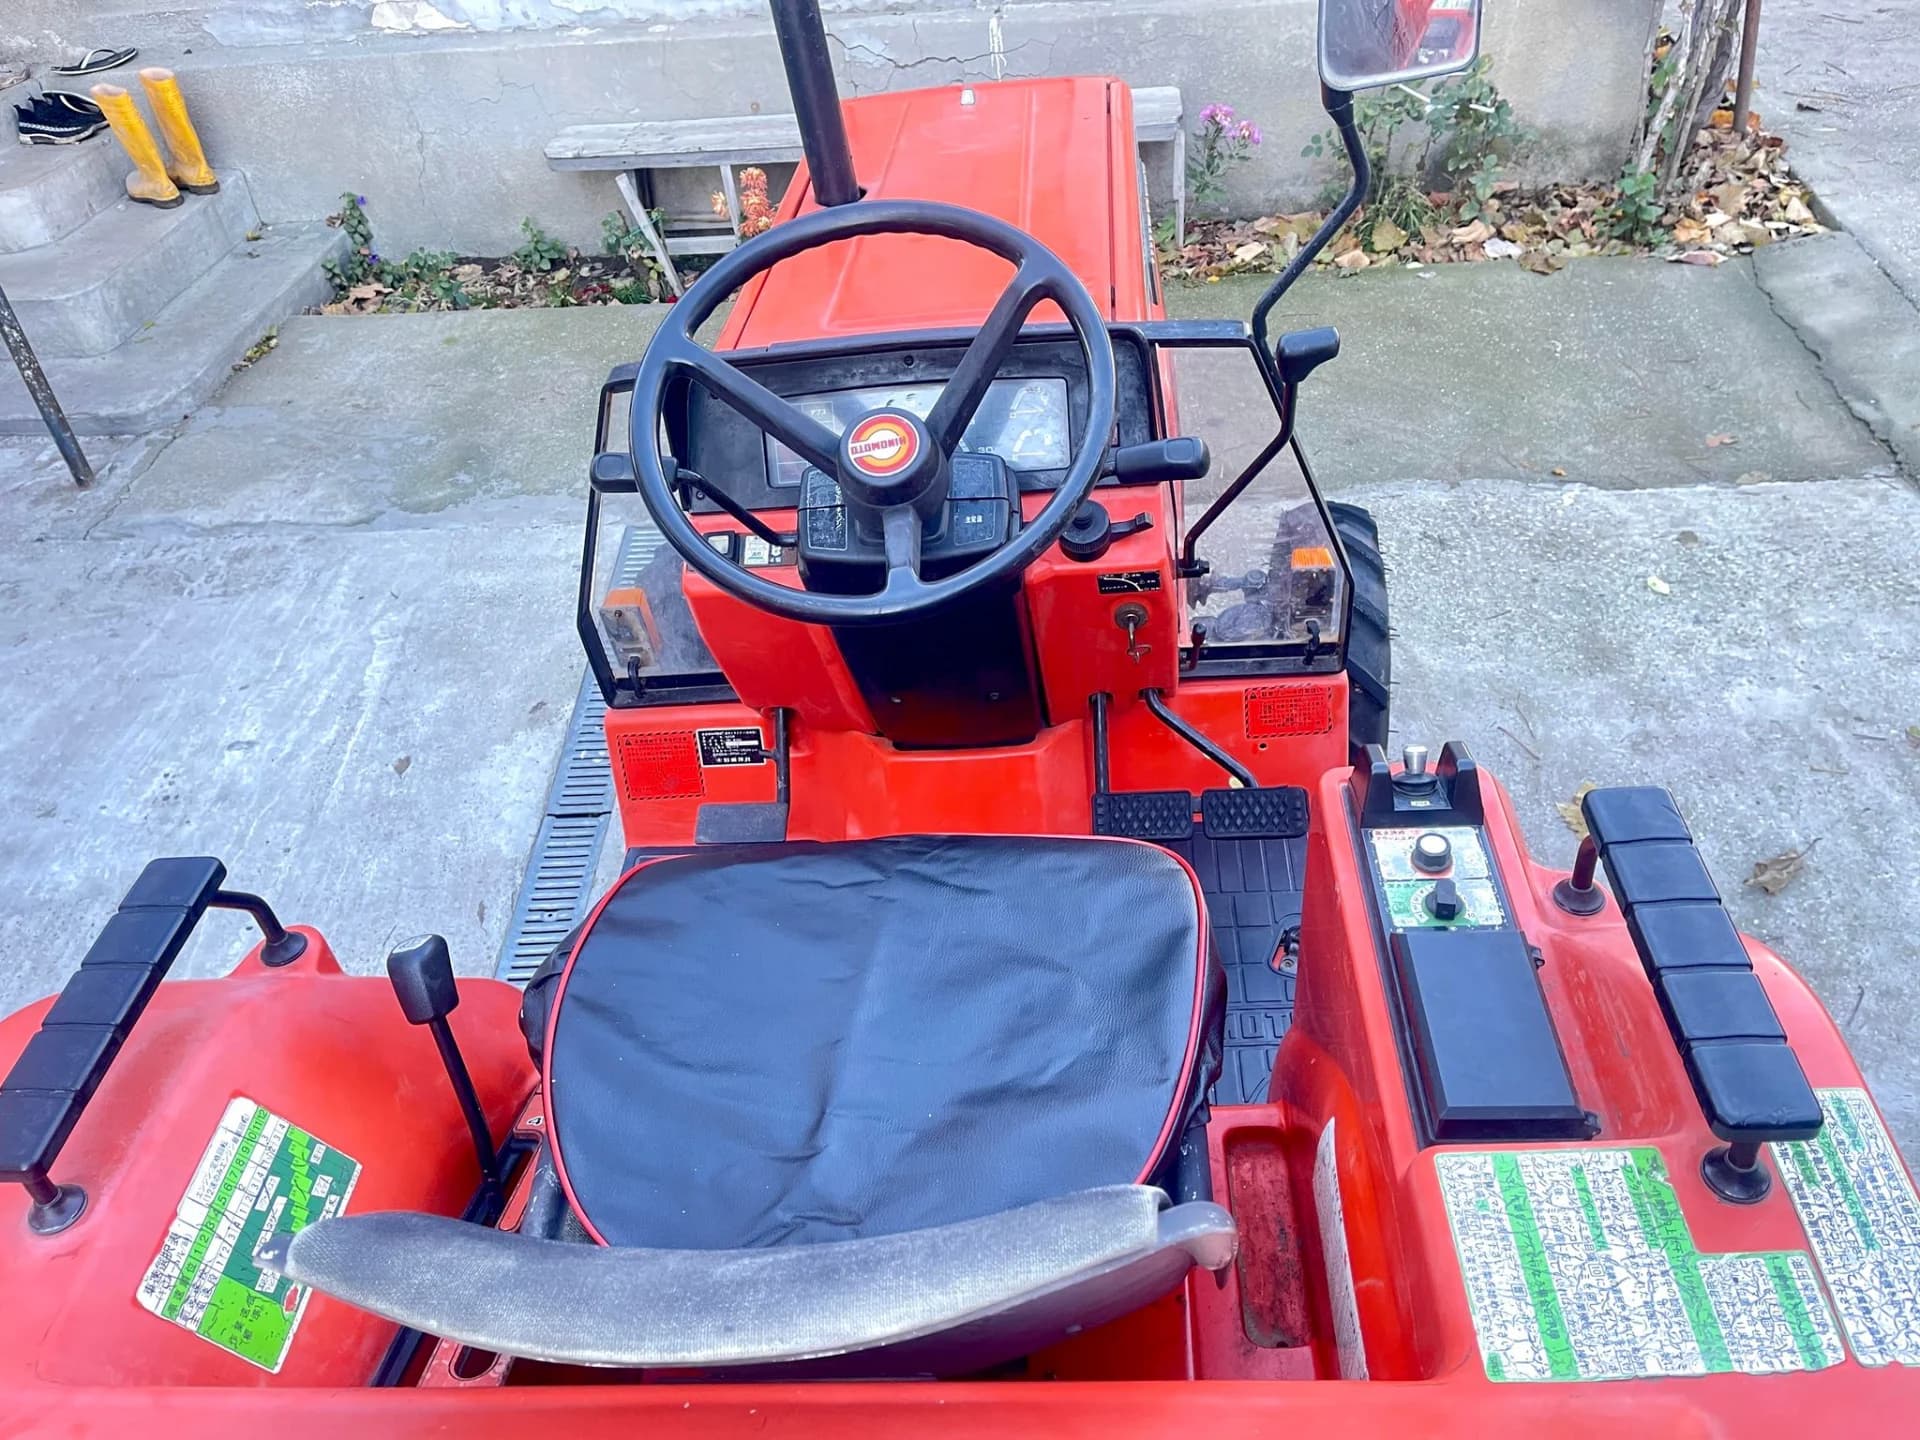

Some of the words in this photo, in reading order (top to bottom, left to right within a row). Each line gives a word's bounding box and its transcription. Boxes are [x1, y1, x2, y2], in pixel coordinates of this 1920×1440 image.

[850, 435, 906, 456] HINOMOTO
[198, 1233, 209, 1243] 2
[216, 1194, 227, 1204] 5
[223, 1182, 233, 1191] 6
[229, 1169, 239, 1179] 7
[234, 1157, 244, 1166] 8
[240, 1144, 250, 1154] 9
